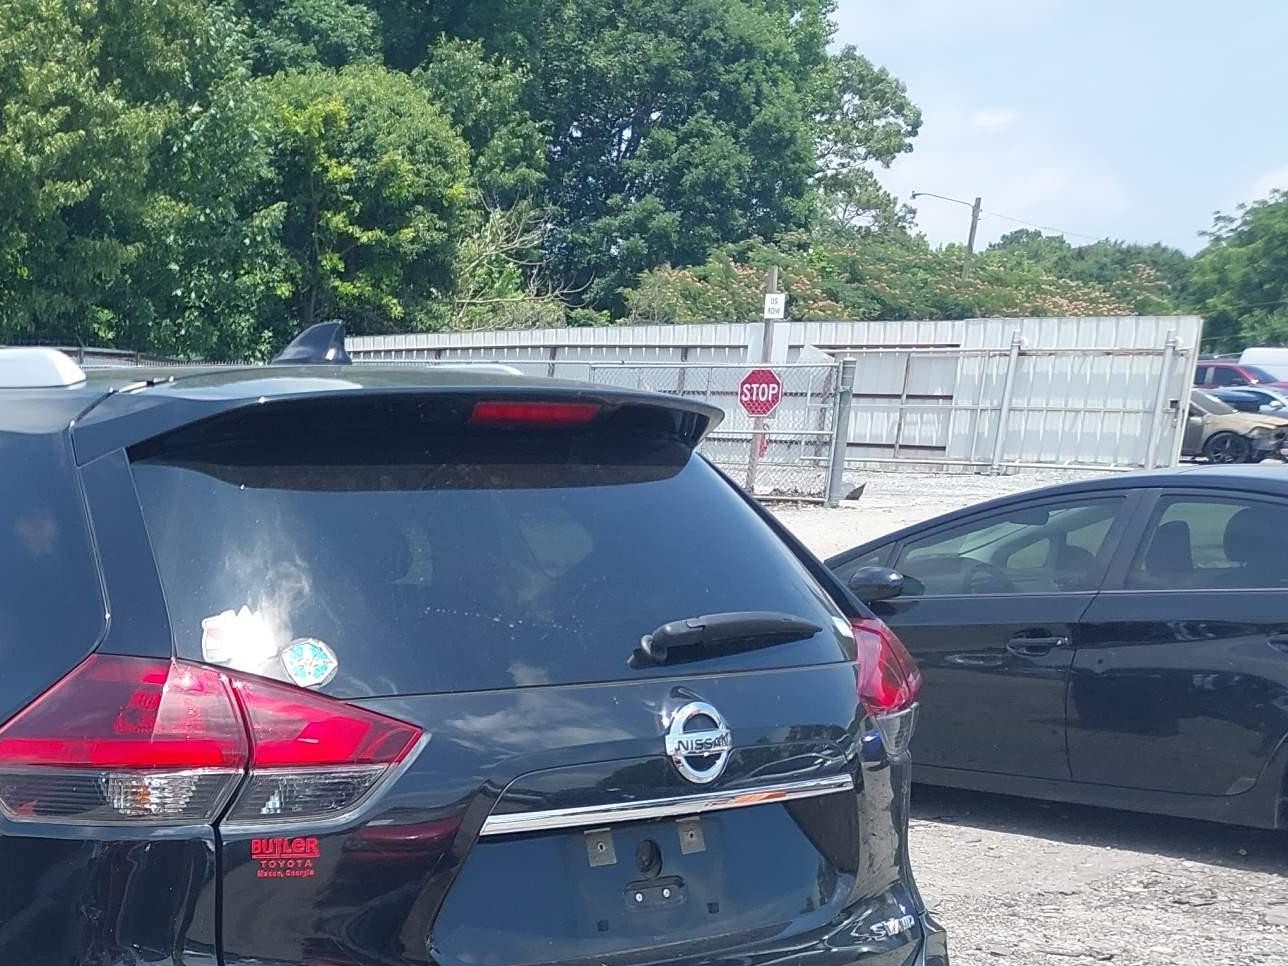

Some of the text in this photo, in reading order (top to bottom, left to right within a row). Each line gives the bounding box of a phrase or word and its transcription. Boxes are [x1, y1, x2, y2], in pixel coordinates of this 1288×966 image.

[742, 384, 778, 401] STOP
[675, 732, 729, 752] NISSAN
[260, 860, 313, 869] TOYOTA
